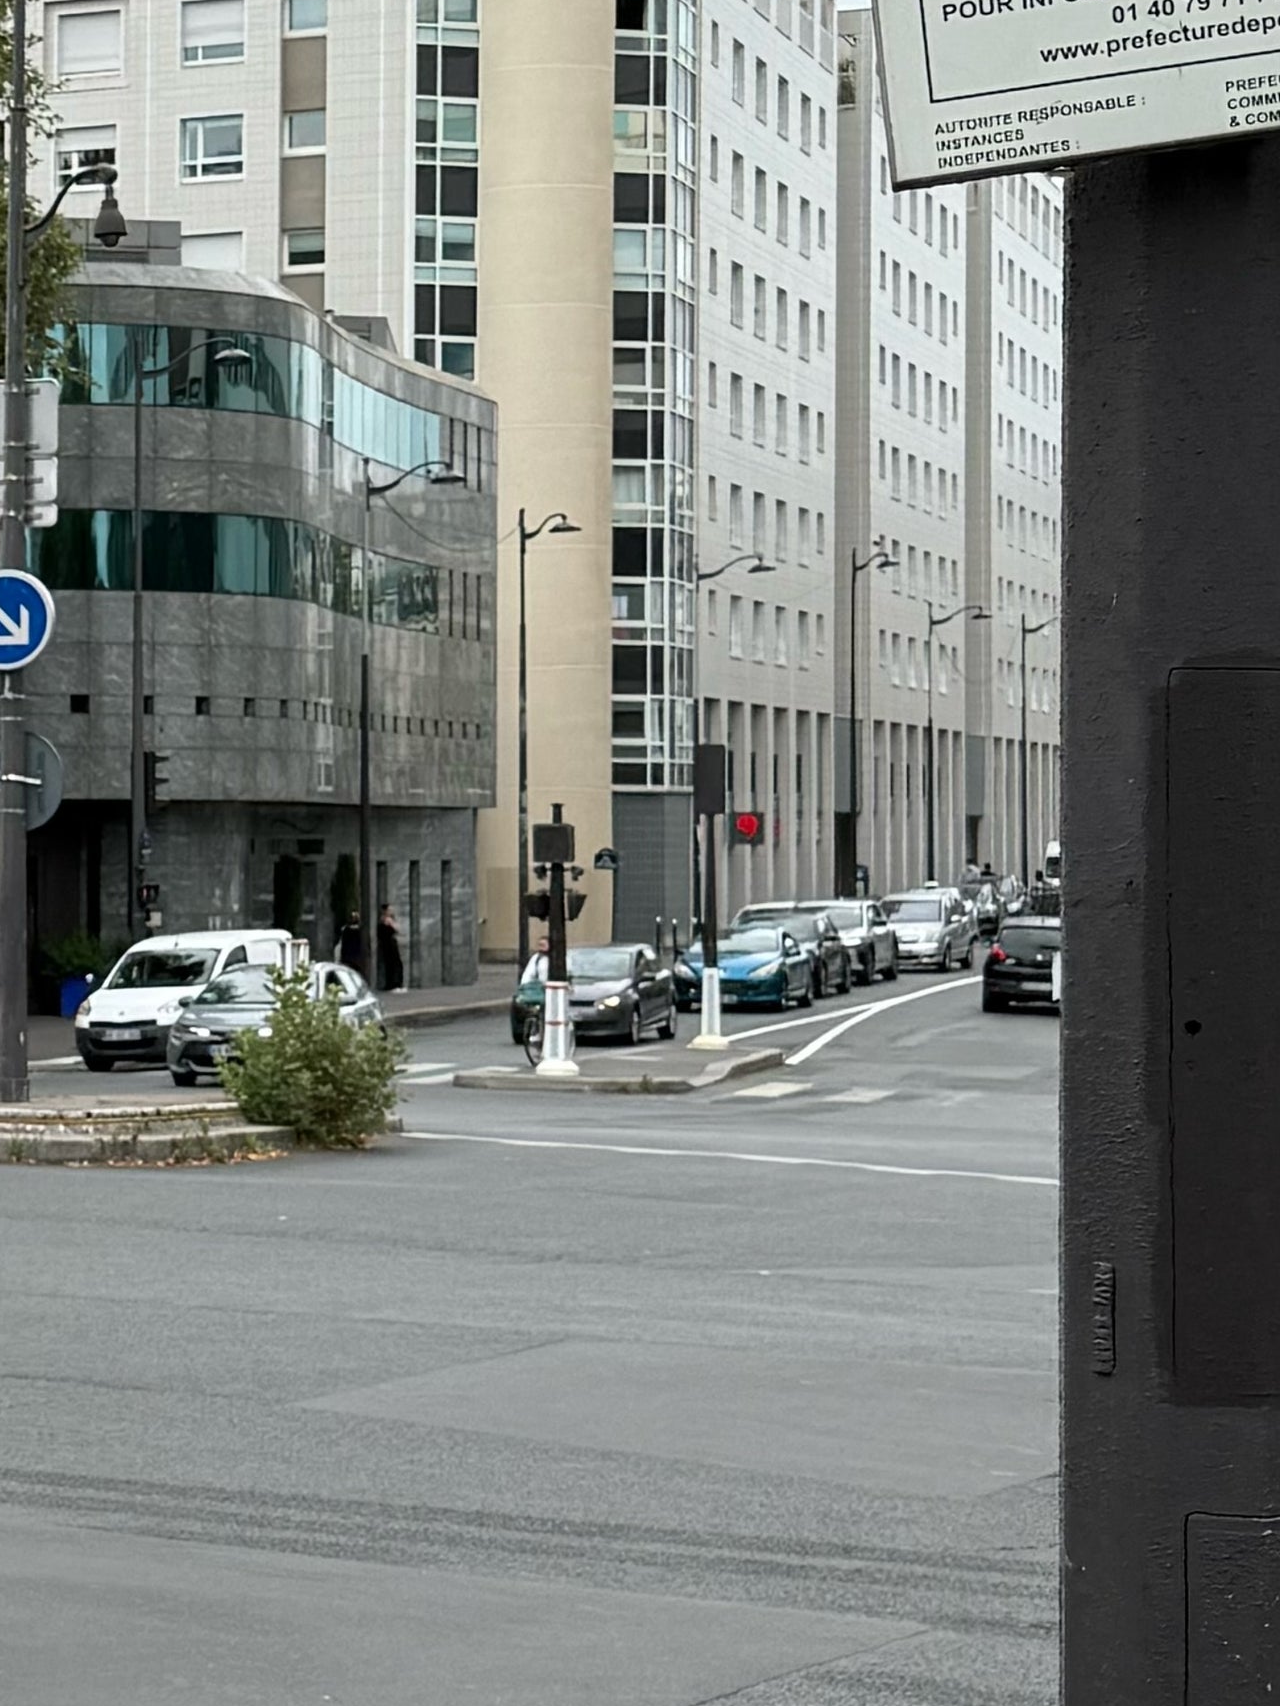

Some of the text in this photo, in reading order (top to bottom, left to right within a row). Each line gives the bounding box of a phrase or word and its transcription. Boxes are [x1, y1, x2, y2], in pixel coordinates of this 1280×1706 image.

[1112, 2, 1138, 23] 01
[1040, 15, 1280, 62] www.prefecturedep
[1225, 74, 1280, 92] PREFE
[1017, 95, 1137, 123] RESPONSABLE
[937, 129, 1024, 151] INSTANCES
[939, 140, 1070, 169] INDEPENDANTES
